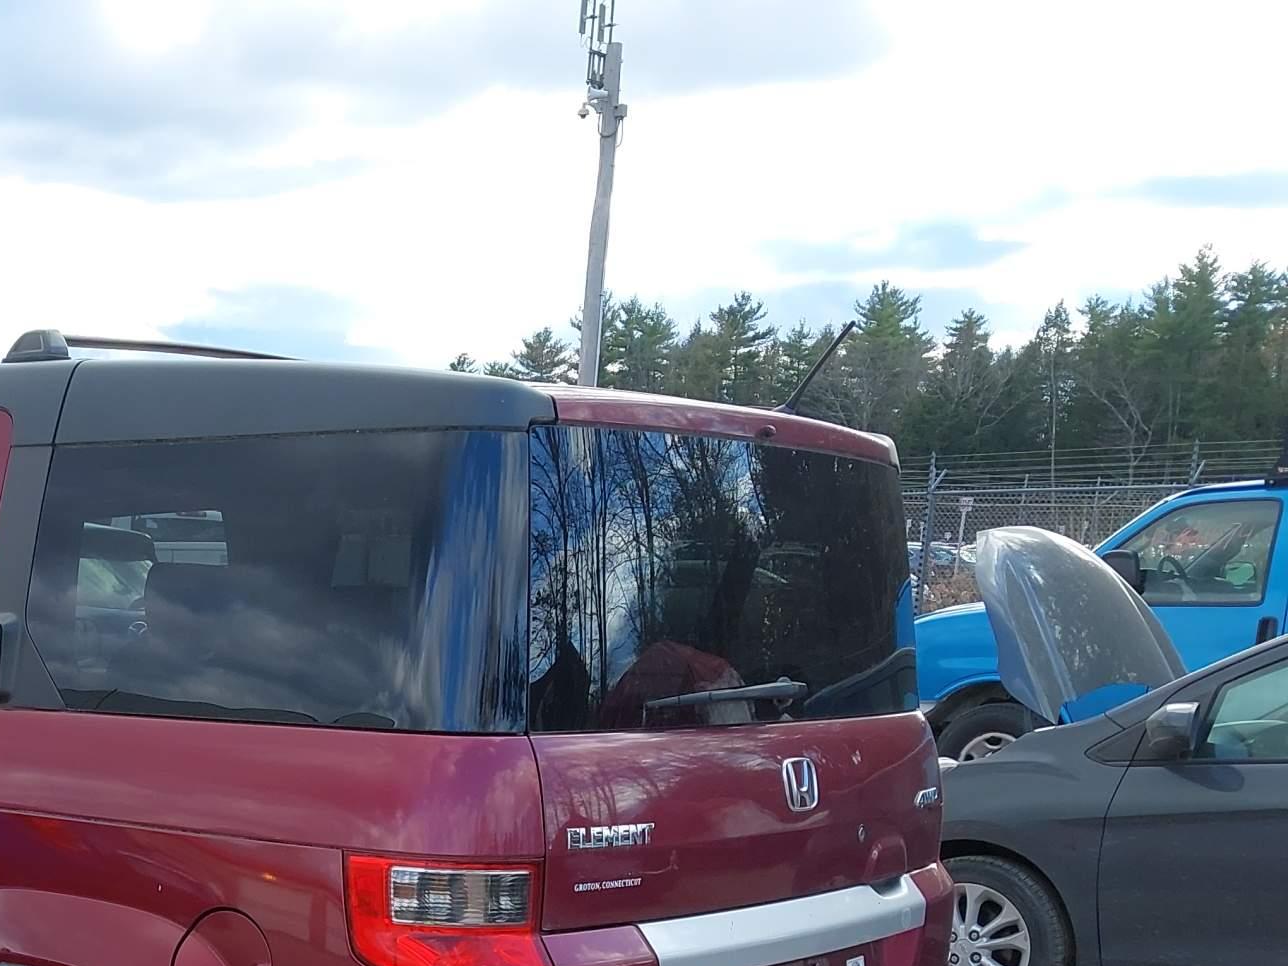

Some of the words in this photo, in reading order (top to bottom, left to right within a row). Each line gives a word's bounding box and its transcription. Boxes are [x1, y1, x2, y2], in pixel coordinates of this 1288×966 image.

[567, 823, 655, 849] ELEMENT
[574, 882, 602, 891] GROTON,
[602, 878, 642, 889] CONNECTICUT
